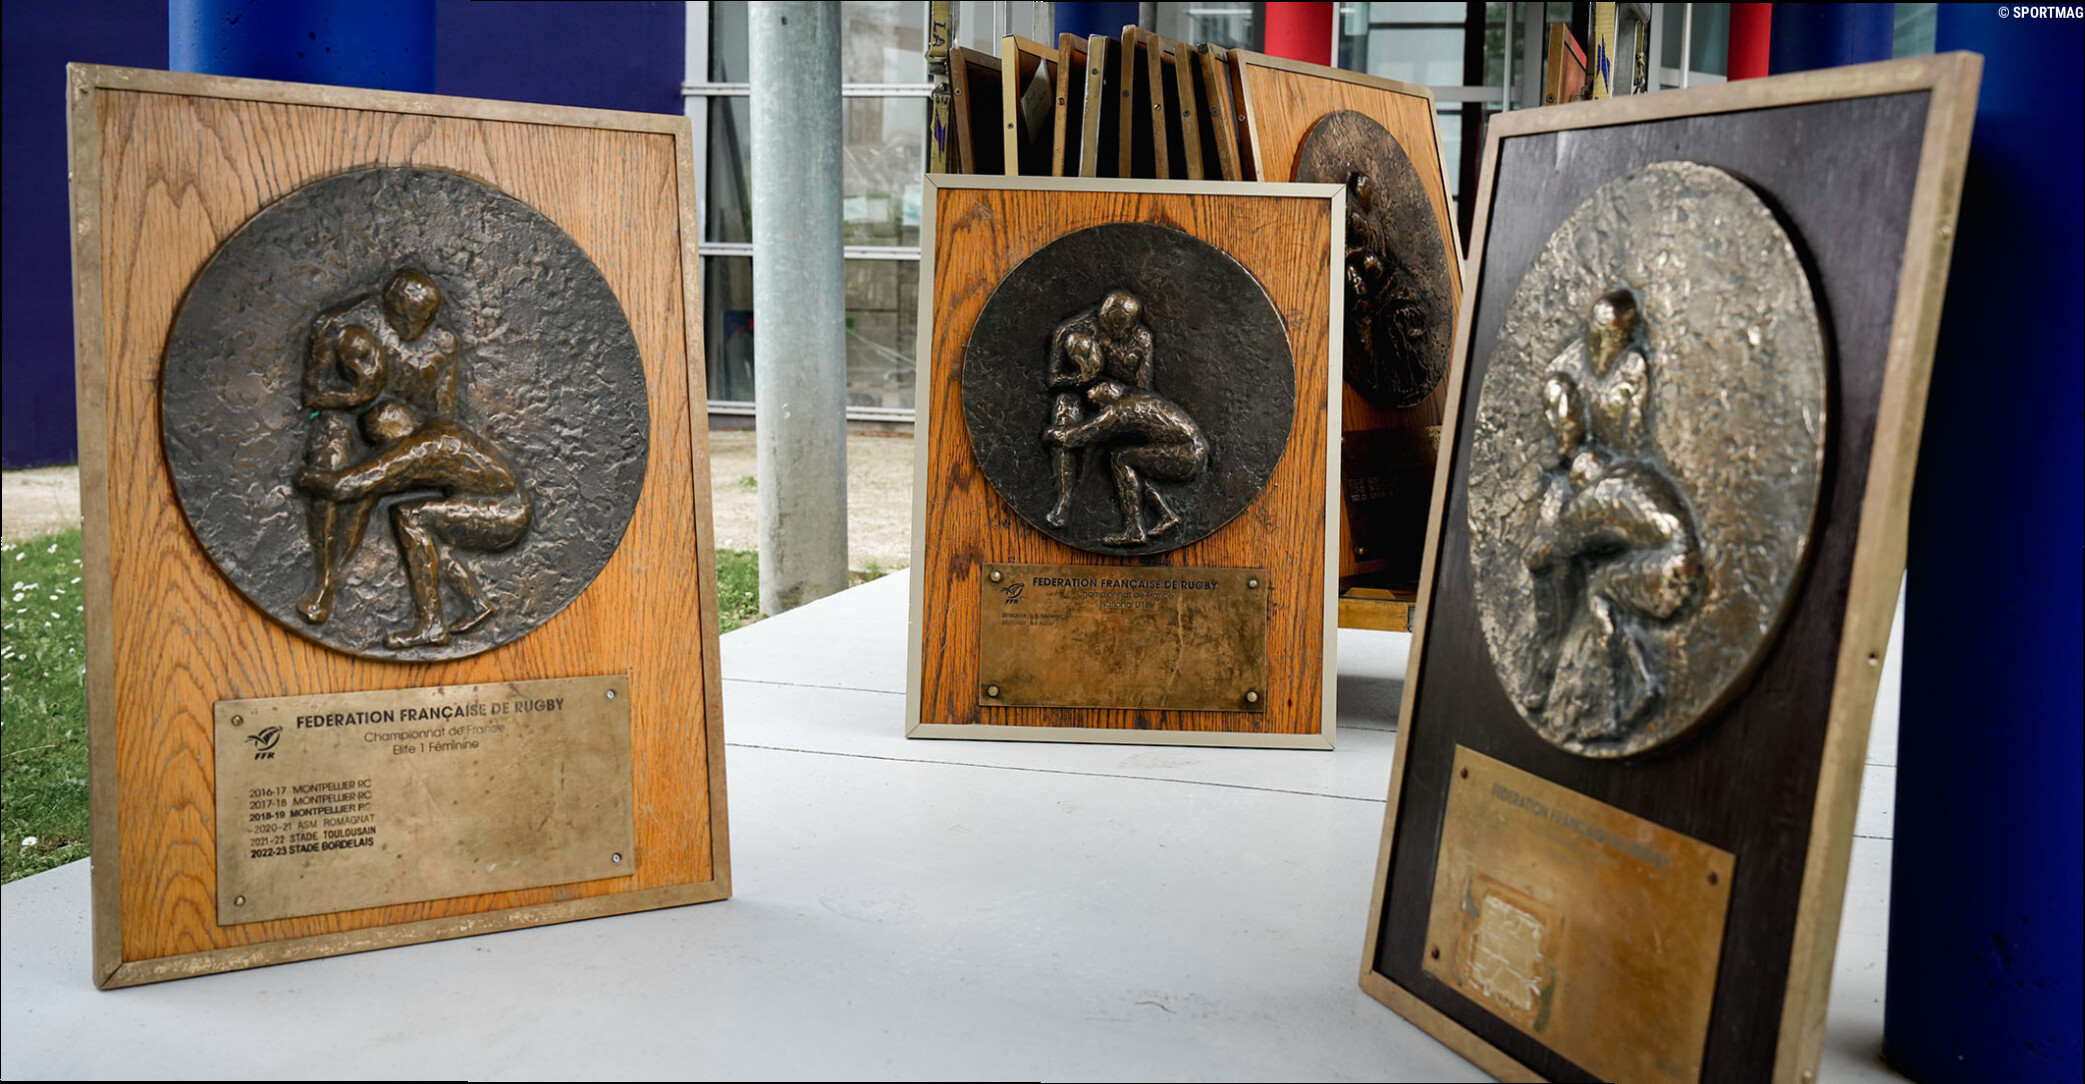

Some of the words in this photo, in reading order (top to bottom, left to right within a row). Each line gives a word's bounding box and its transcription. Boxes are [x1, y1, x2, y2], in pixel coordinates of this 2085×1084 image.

[1033, 577, 1097, 587] FEDERATION
[1100, 578, 1161, 590] FRANÇAISE
[1164, 580, 1177, 589] DE
[1181, 580, 1218, 590] RUGBY
[296, 710, 395, 729] FEDERATION
[400, 703, 487, 722] FRANÇAISE
[491, 702, 509, 715] DE
[515, 698, 564, 713] RUGBY
[364, 727, 445, 743] Championnat
[449, 726, 462, 736] de
[467, 724, 505, 735] France
[254, 752, 275, 760] FFR
[392, 744, 416, 755] Elite
[420, 743, 425, 753] 1
[429, 740, 479, 752] Féminine
[249, 786, 286, 798] 2016-17
[292, 780, 355, 795] MONTPELLIER
[357, 779, 371, 788] RC
[249, 799, 287, 810] 2017-18
[292, 792, 355, 806] MONTPELLIER
[357, 790, 371, 800] RC
[249, 810, 285, 822] 2018-19
[289, 803, 355, 818] MONTPELLIER
[297, 820, 317, 830] ASM
[323, 814, 375, 827] ROMAGNAT
[250, 835, 285, 847] 2021-22
[290, 831, 318, 843] STADE
[323, 826, 376, 839] TOULOUSAIN
[250, 846, 287, 859] 2022-23
[289, 842, 320, 855] STADE
[321, 837, 374, 851] BORDELAIS
